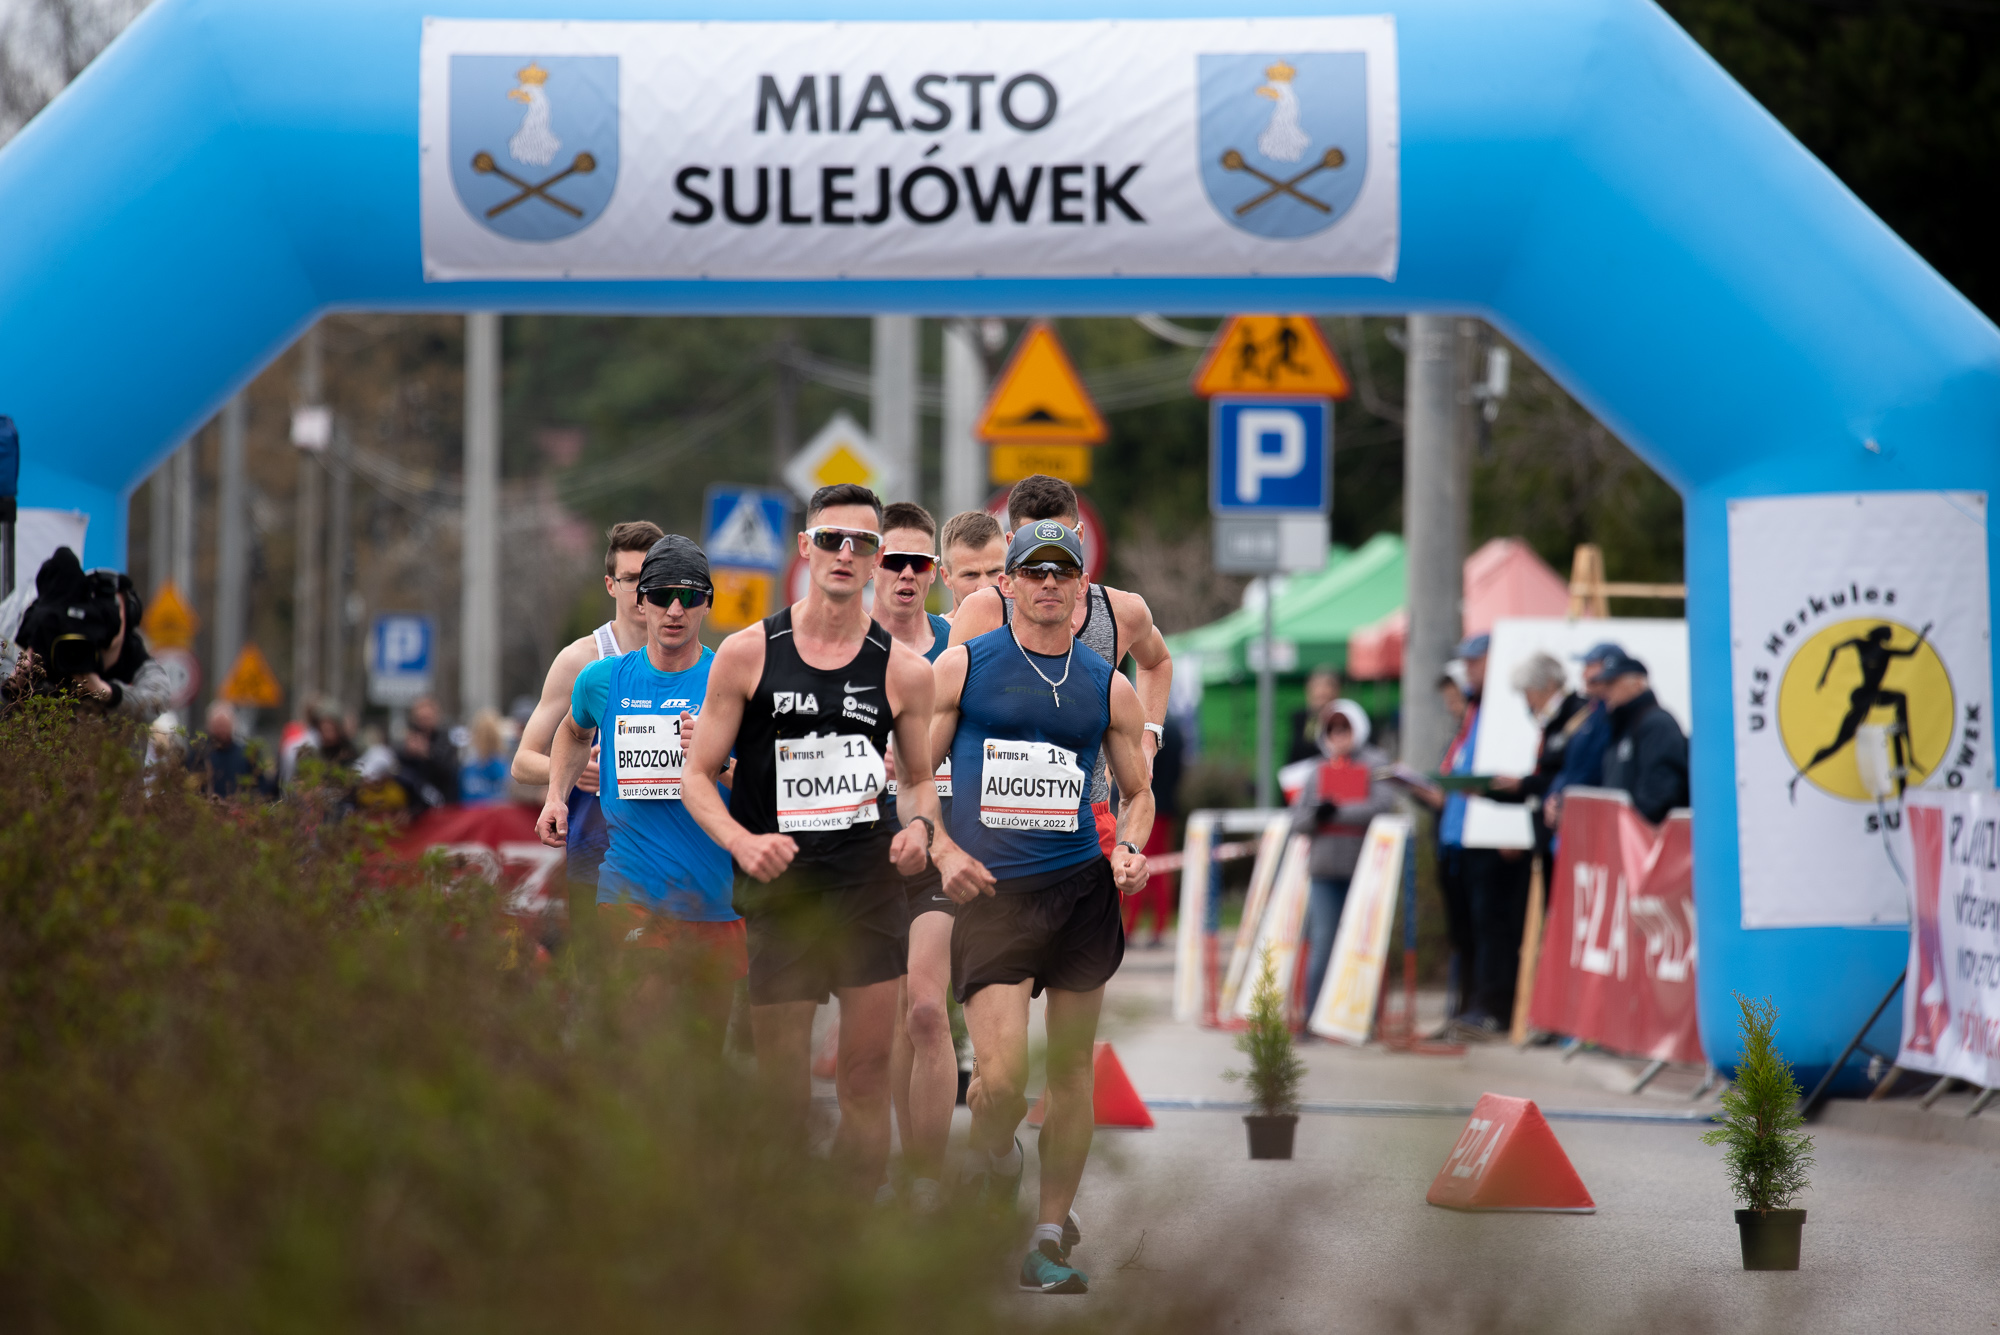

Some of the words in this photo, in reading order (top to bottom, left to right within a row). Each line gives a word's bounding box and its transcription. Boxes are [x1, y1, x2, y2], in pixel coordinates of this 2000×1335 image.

[755, 73, 1058, 133] MIASTO
[669, 145, 1148, 229] SULEJÓWEK
[1236, 409, 1307, 503] P
[1749, 667, 1770, 732] UKS
[1767, 581, 1898, 657] Herkules
[843, 741, 868, 758] 11
[1047, 748, 1067, 766] 18
[622, 787, 669, 797] SULEJÓWEK
[783, 773, 878, 798] TOMALA
[985, 776, 1081, 799] AUGUSTYN
[784, 816, 843, 829] SULEJÓWEK
[985, 816, 1040, 828] SULEJÓWEK
[1043, 819, 1066, 828] 2022
